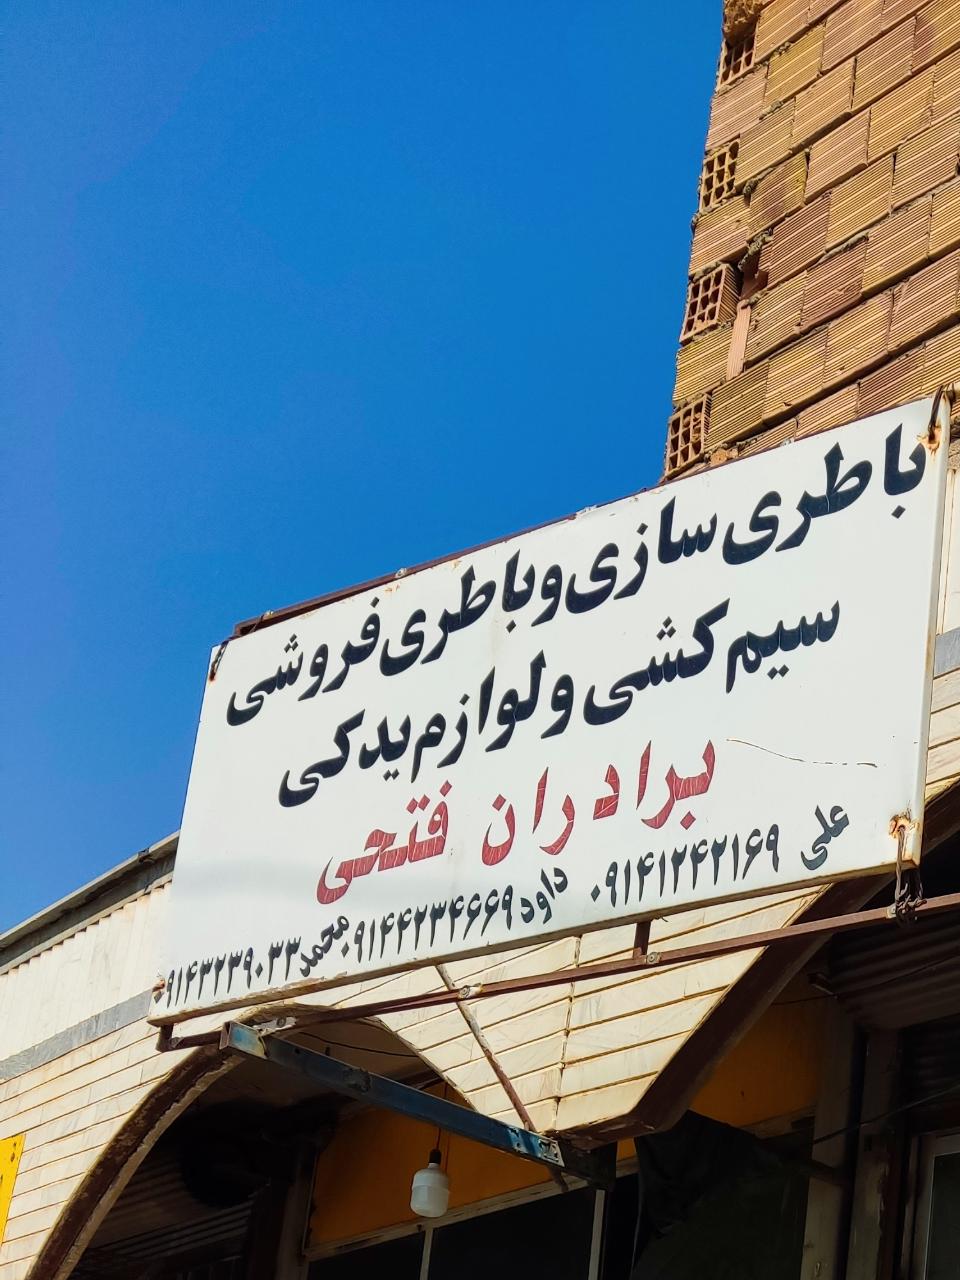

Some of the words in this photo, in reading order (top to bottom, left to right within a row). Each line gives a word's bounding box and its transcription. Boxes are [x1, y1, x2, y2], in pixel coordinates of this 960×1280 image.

[722, 423, 927, 566] باطری
[564, 498, 718, 615] سازی
[226, 596, 381, 727] فروشی
[582, 598, 731, 726] کشی
[726, 599, 840, 694] سیم
[278, 708, 412, 808] یدکی
[481, 739, 716, 867] برادران
[316, 780, 449, 905] فتحی
[590, 823, 780, 908] ۰۹۱۴۱۲۴۲۱۶۹
[800, 805, 850, 871] علی
[299, 915, 350, 977] محمد
[519, 867, 569, 925] داود
